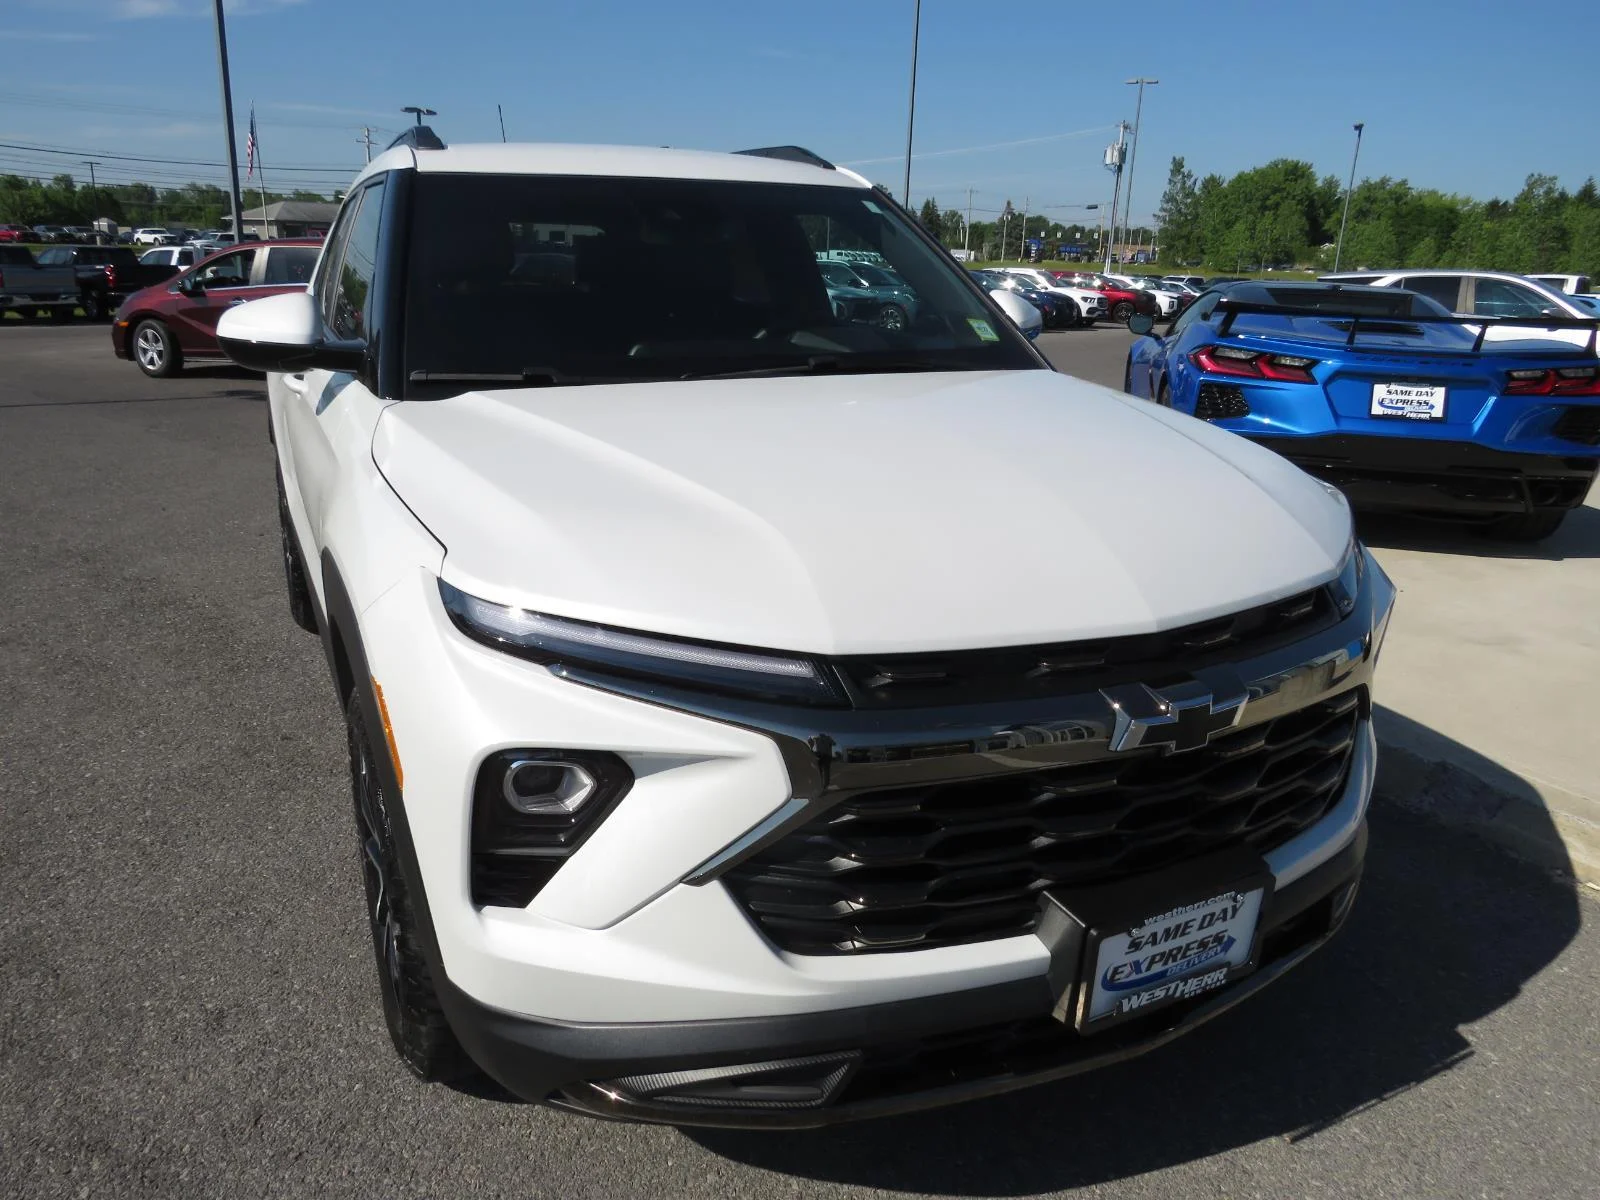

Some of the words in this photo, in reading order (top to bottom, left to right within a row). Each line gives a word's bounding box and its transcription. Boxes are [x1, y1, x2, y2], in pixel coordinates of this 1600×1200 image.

[1381, 398, 1430, 406] EXPRESS
[1386, 389, 1414, 397] SAME
[1415, 390, 1436, 398] DAY
[1126, 918, 1196, 955] SAME
[1197, 901, 1244, 931] DAY
[1109, 929, 1228, 982] EXPRESS
